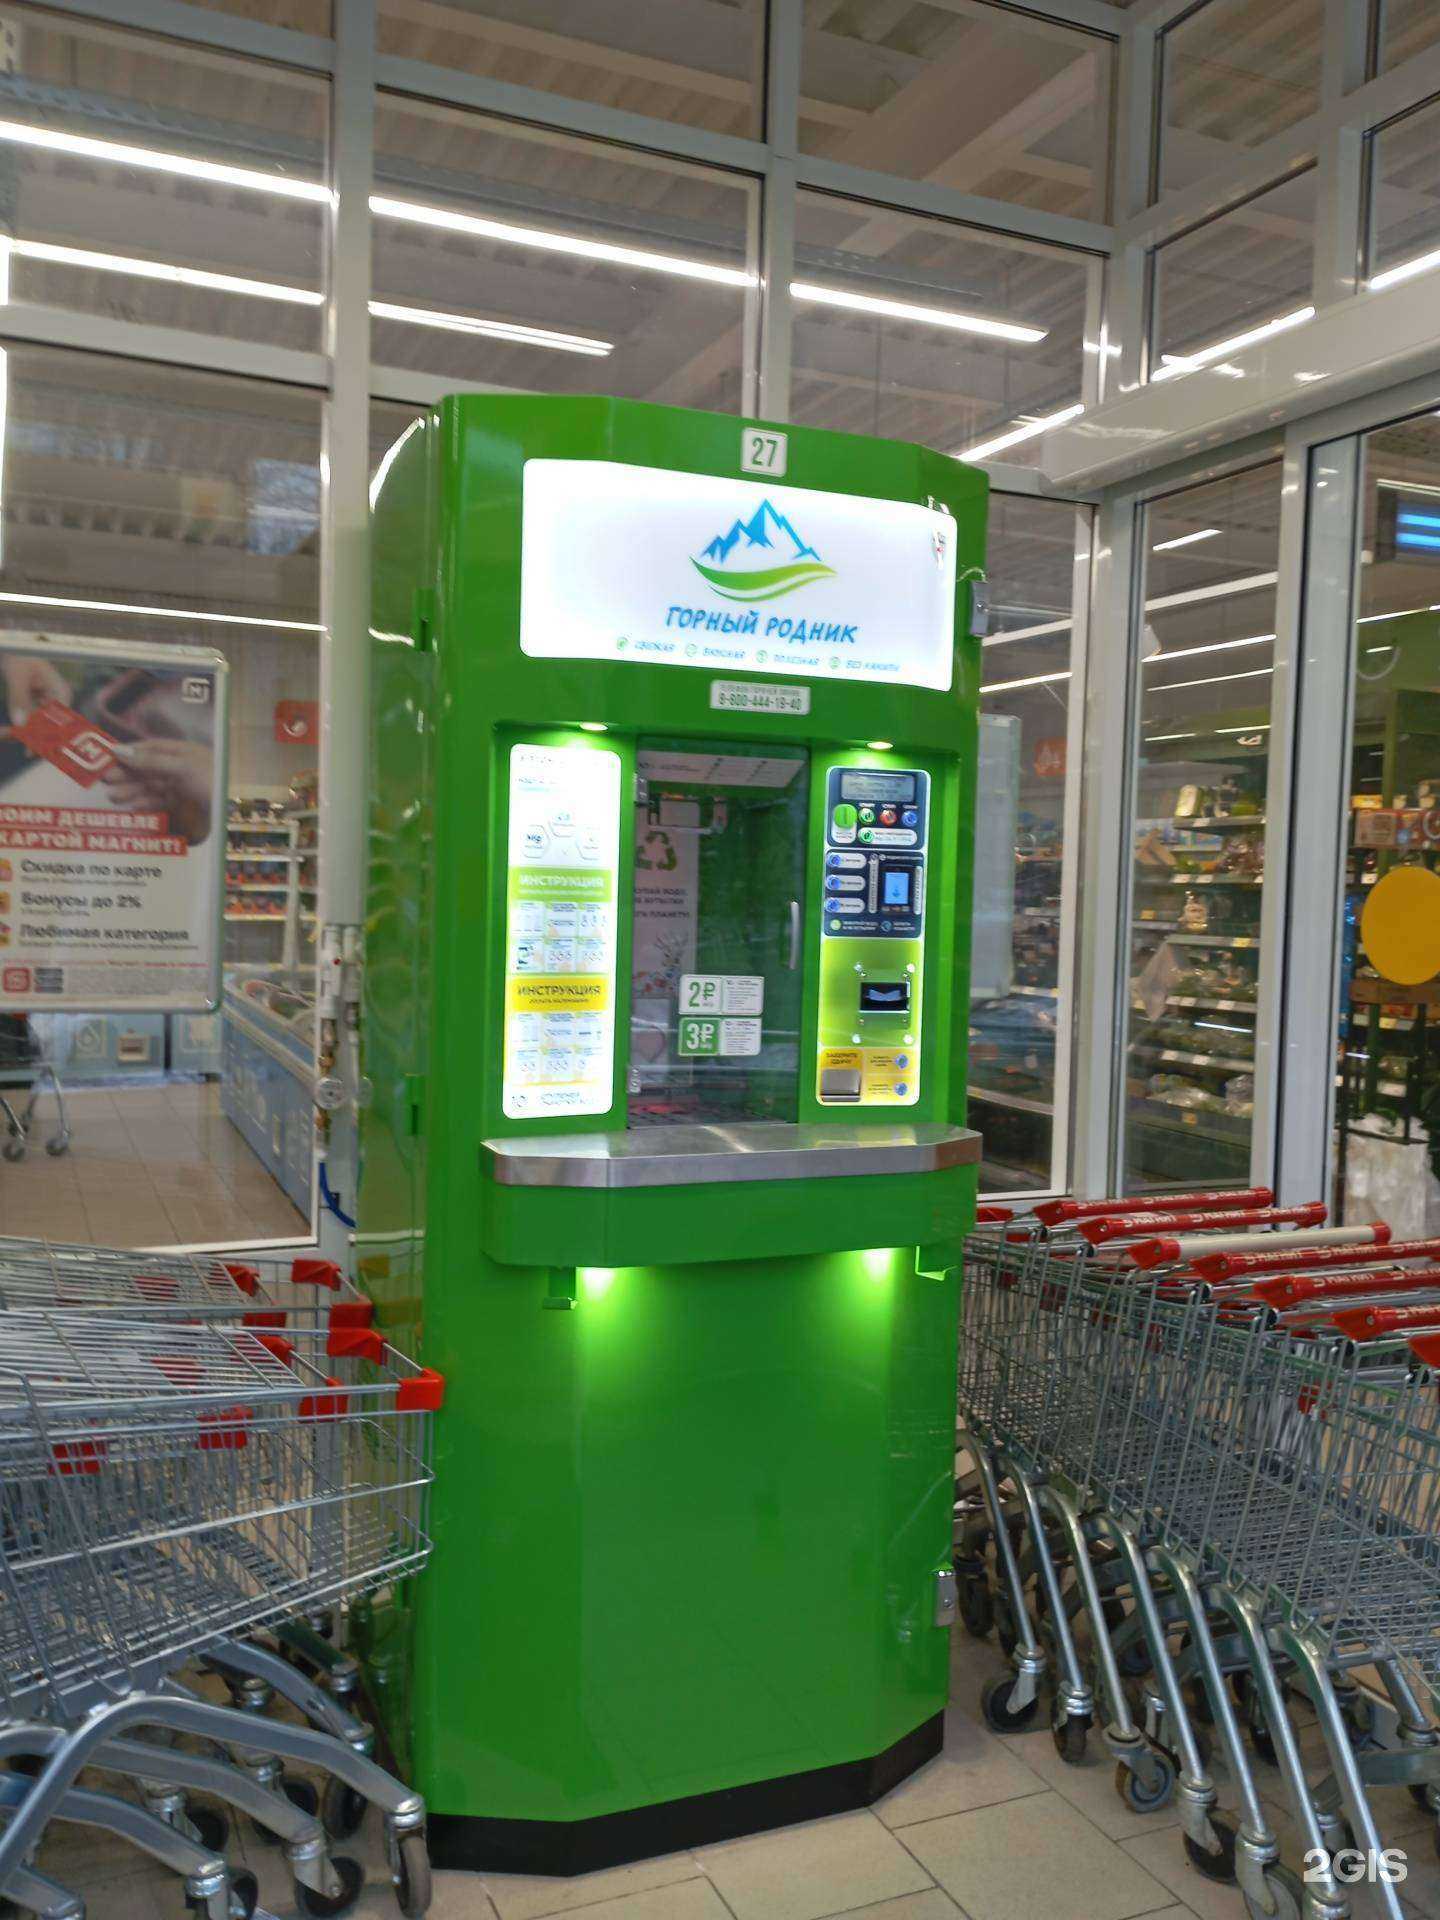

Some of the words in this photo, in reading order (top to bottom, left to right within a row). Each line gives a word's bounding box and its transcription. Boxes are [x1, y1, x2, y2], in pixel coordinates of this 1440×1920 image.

[751, 437, 777, 467] 27
[665, 606, 760, 635] ГОРНЫЙ
[766, 616, 858, 645] РОДНИК
[58, 809, 160, 831] ДЕШЕВЛЕ
[88, 834, 182, 854] МАГНИТ!
[20, 858, 86, 875] Скидка
[89, 865, 111, 876] по
[113, 866, 163, 880] карте
[519, 875, 605, 889] ИНСТРУКЦИЯ
[20, 890, 88, 909] Бонусы
[91, 896, 114, 909] до
[116, 893, 143, 909] 2%
[20, 923, 101, 939] Любимая
[103, 928, 190, 944] категория
[518, 984, 602, 996] ИНСТРУКЦИЯ
